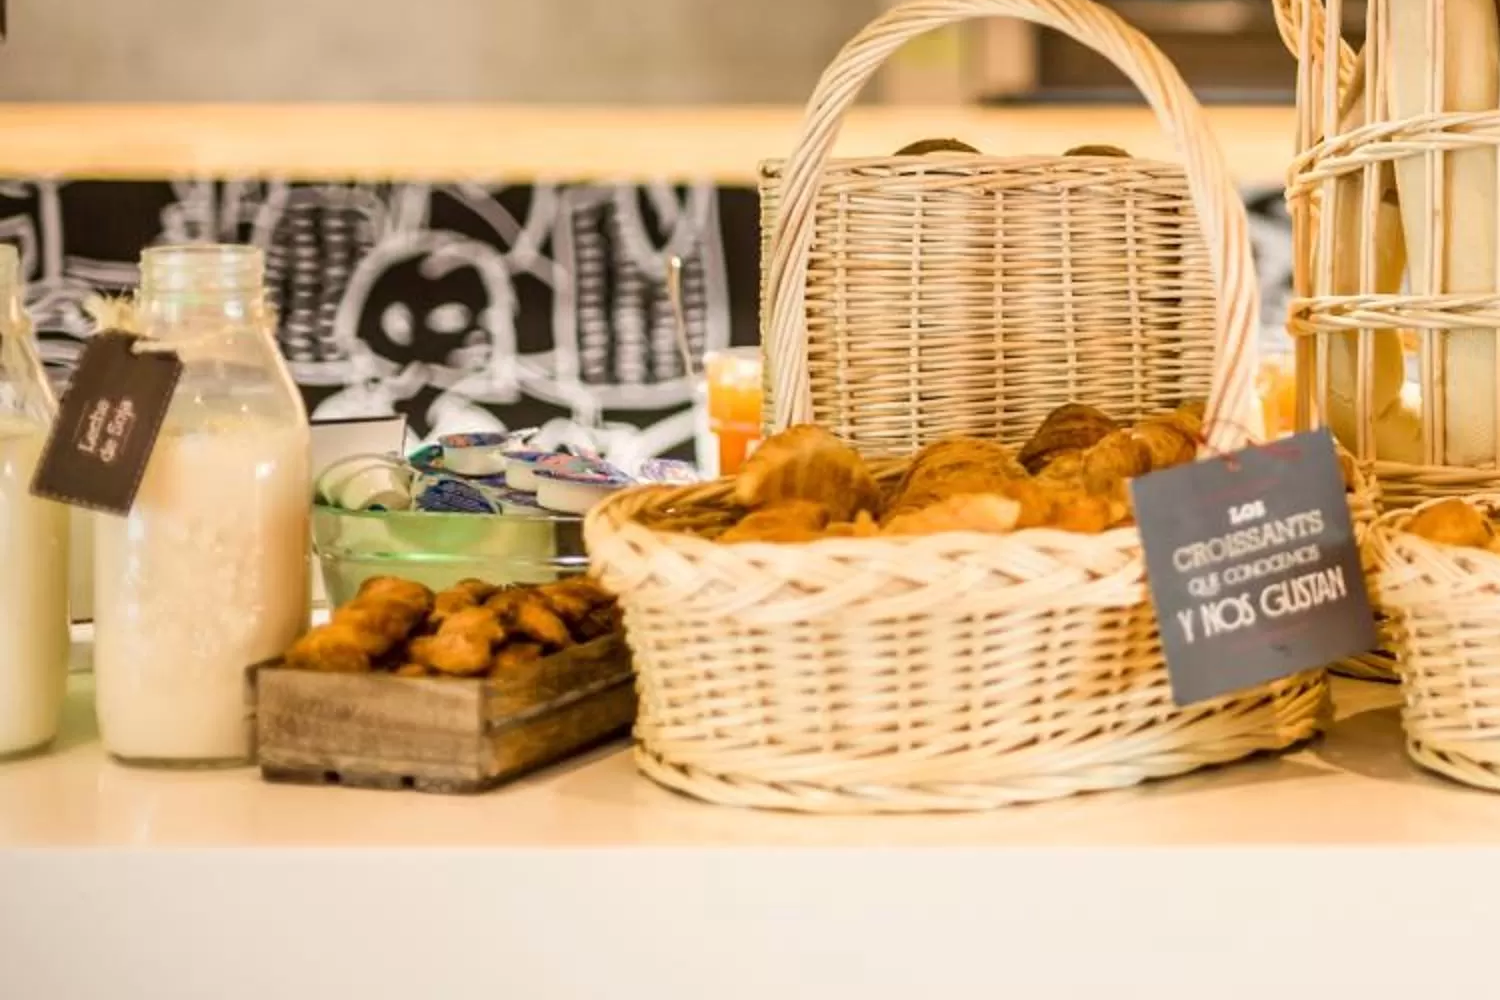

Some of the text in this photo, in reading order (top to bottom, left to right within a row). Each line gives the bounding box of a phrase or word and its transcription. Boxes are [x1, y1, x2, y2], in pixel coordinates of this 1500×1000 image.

[1172, 509, 1324, 572] CROISSANTS
[1188, 544, 1320, 597] QUE CONOCEMOS
[1177, 565, 1347, 643] Y NOS GUSTAN
